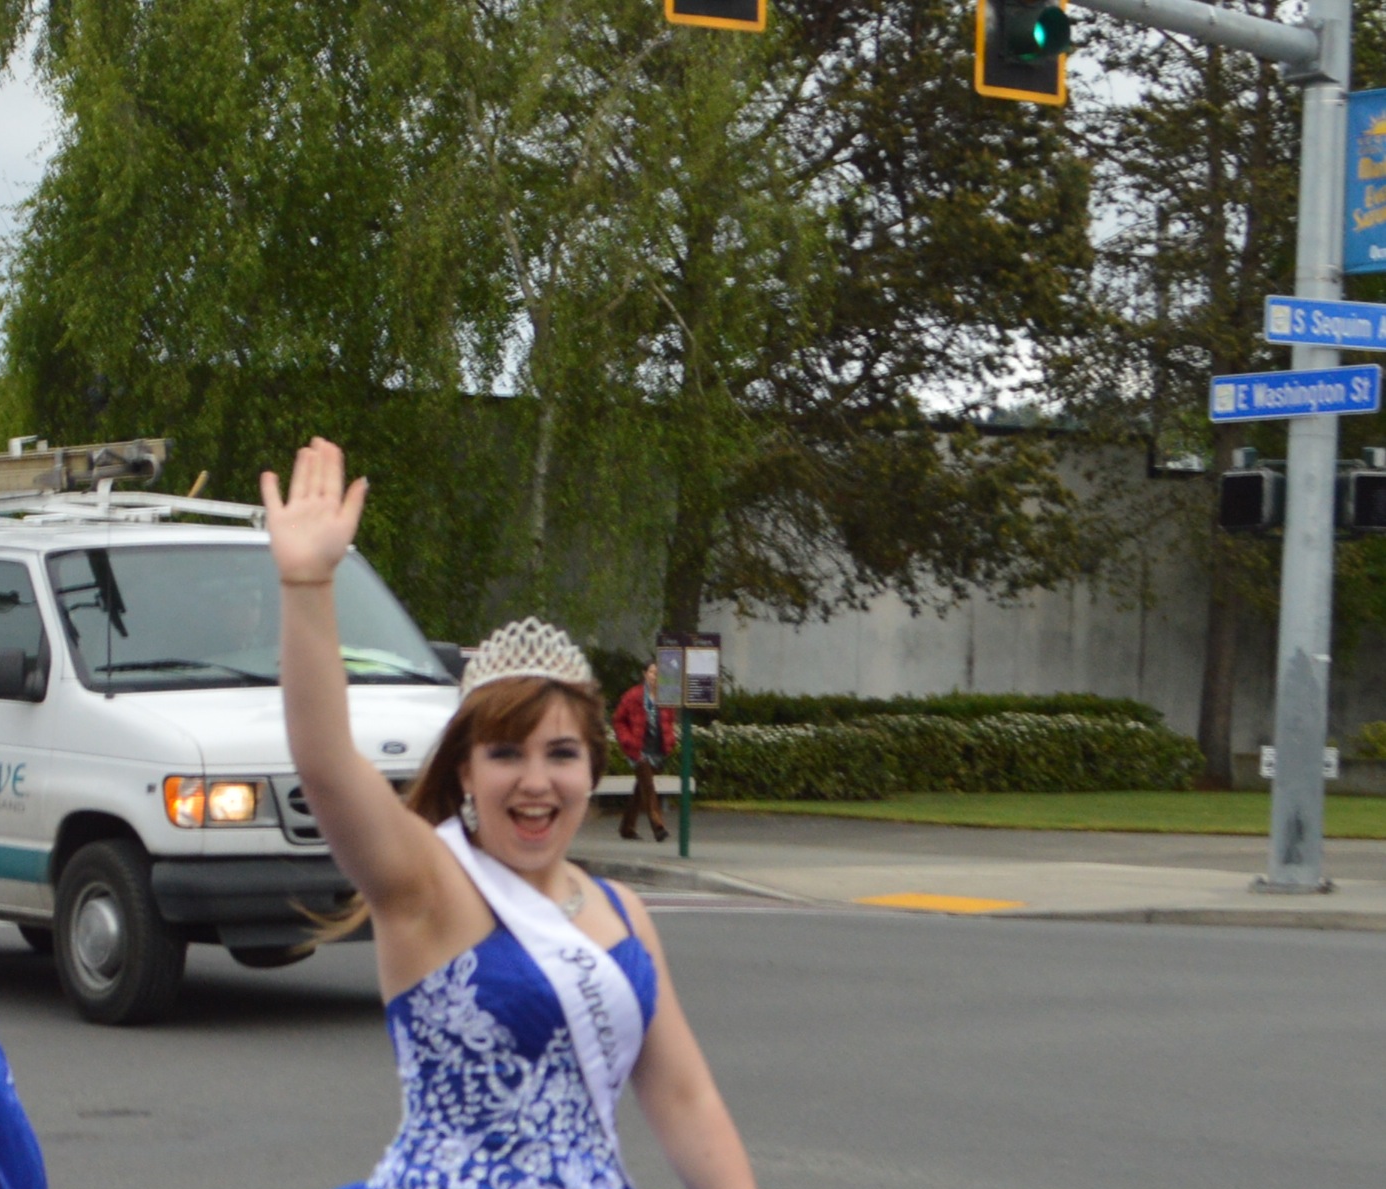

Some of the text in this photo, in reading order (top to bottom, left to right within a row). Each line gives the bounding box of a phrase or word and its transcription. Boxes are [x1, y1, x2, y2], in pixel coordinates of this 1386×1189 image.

[1294, 308, 1306, 335] S
[1311, 309, 1372, 344] Sequim
[1237, 376, 1371, 412] E Washington St
